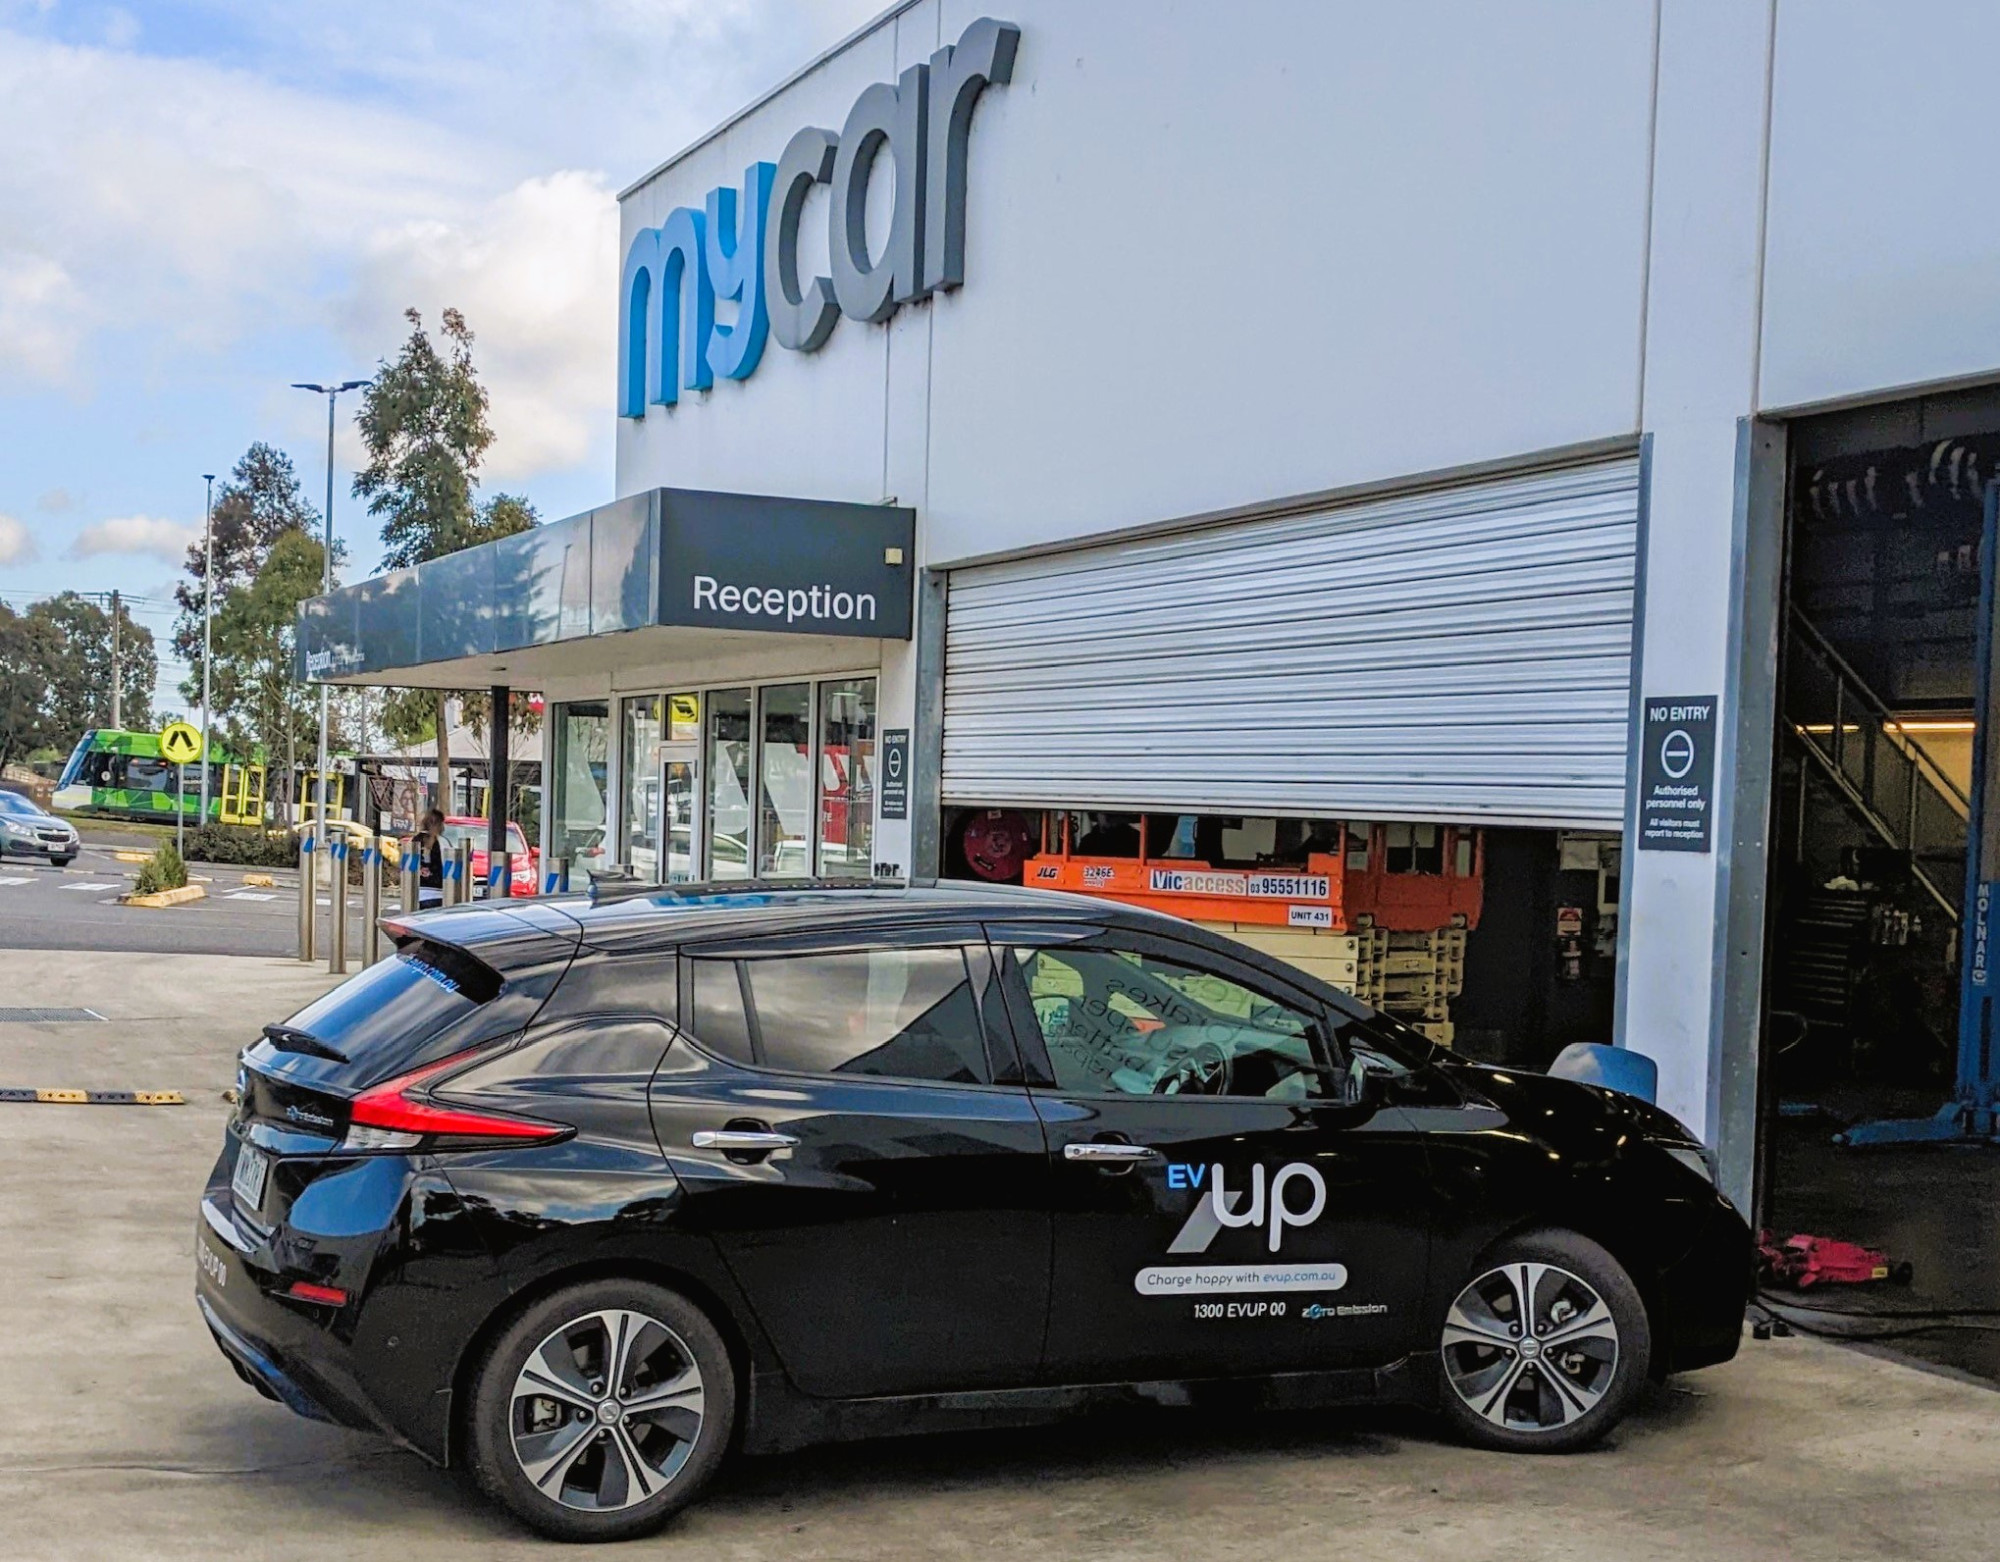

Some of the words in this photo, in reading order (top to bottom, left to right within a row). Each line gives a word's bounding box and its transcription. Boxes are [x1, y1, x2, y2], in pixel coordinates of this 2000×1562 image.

[617, 16, 1021, 419] mycar
[693, 575, 876, 623] Reception
[1650, 706, 1668, 721] NO
[1670, 705, 1710, 720] ENTRY
[1653, 785, 1699, 796] Authorised
[1645, 798, 1687, 810] personnel
[1687, 798, 1706, 811] only
[1037, 866, 1057, 879] JLG
[1250, 883, 1261, 894] 03
[1262, 878, 1327, 897] 95551116
[1290, 911, 1312, 921] UNIT
[1313, 912, 1330, 922] 431
[1975, 884, 1989, 969] MOLNAR
[1167, 1164, 1205, 1188] EV
[1211, 1162, 1327, 1252] up
[1147, 1273, 1192, 1288] Charge
[1195, 1272, 1233, 1286] happy
[1235, 1272, 1260, 1284] with
[1263, 1271, 1336, 1284] evup.com.au
[1194, 1303, 1224, 1318] 1300
[1227, 1303, 1268, 1318] EVUP
[1269, 1302, 1286, 1316] 00
